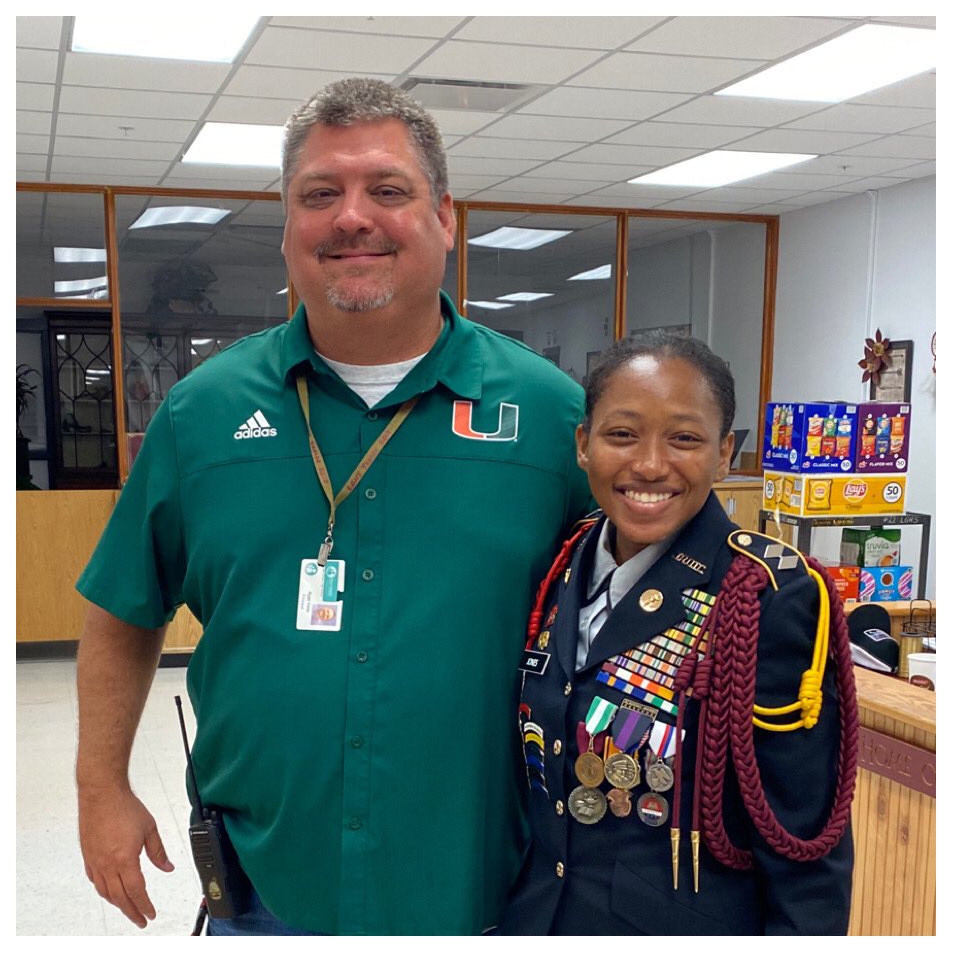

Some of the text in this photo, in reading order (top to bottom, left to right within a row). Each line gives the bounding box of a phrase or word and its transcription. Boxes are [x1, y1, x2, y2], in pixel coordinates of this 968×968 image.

[452, 400, 519, 441] U
[233, 427, 277, 440] adidas
[845, 484, 867, 497] Lay's
[886, 485, 899, 495] 50
